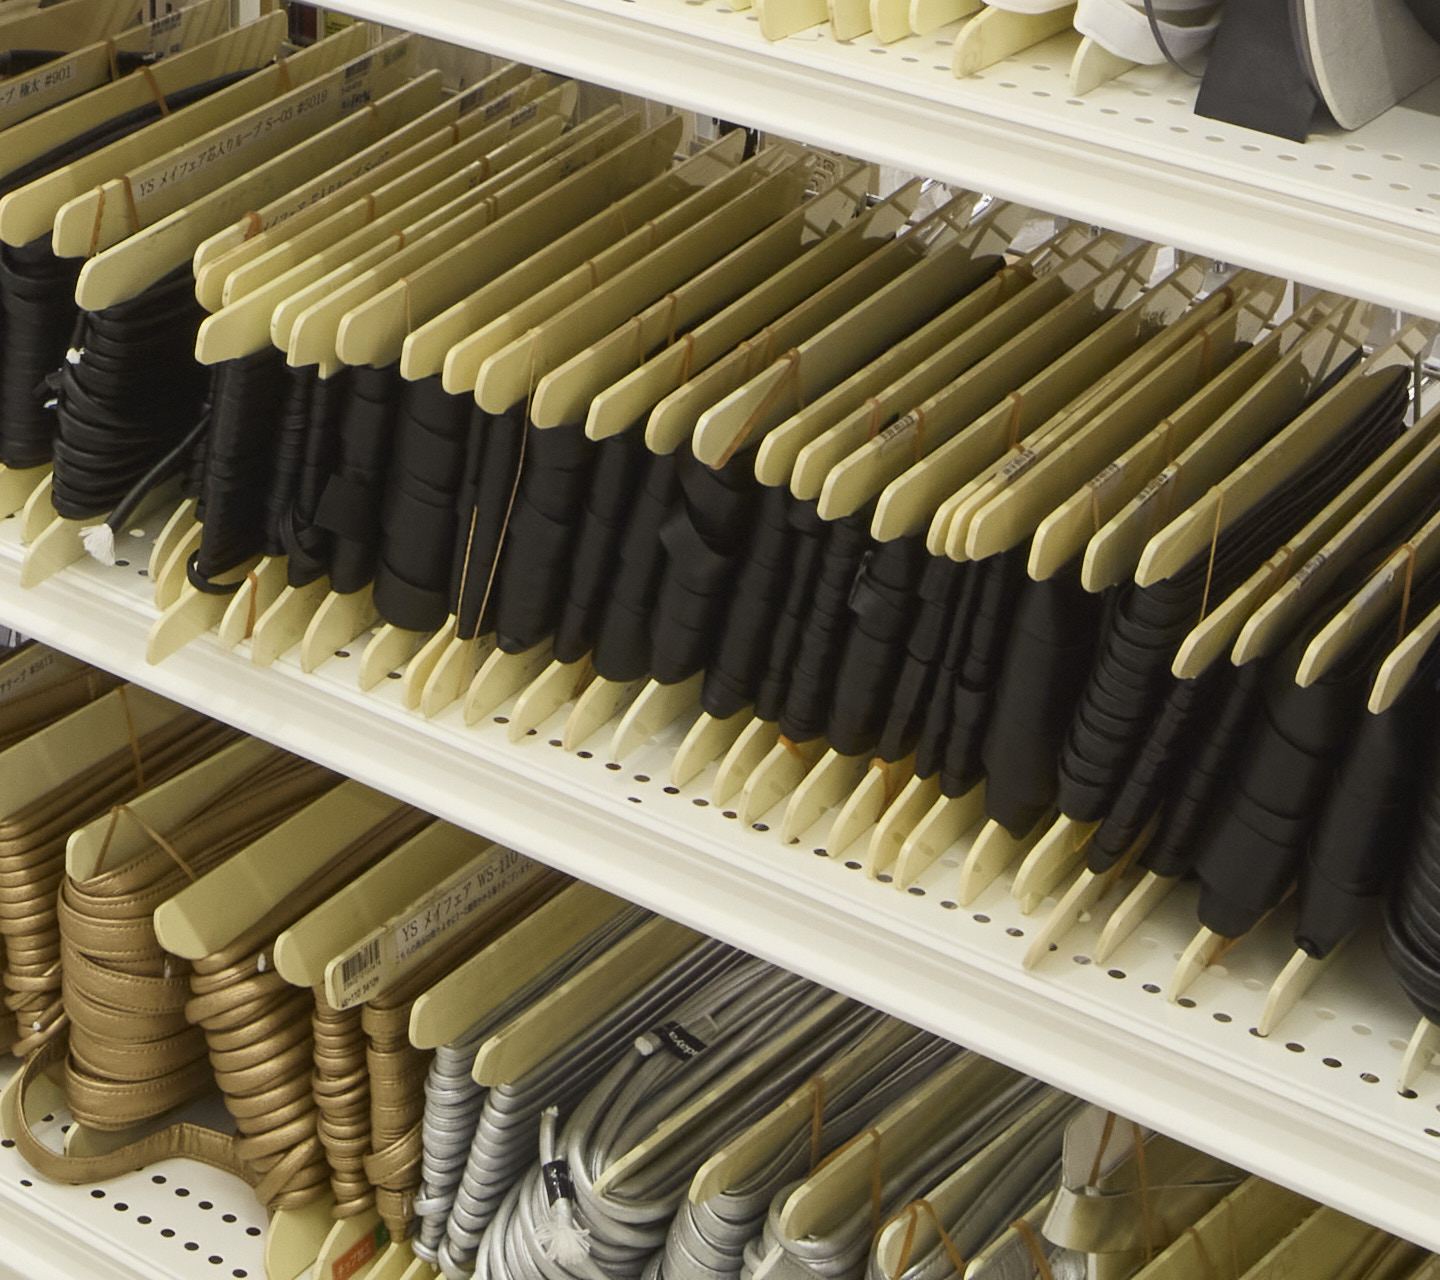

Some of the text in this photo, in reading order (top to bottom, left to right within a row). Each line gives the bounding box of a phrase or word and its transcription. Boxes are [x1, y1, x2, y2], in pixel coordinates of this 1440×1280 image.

[18, 78, 41, 100] 極太
[44, 66, 73, 90] #901
[138, 181, 156, 197] YS
[401, 920, 421, 942] YS
[423, 882, 473, 930] メイフェア
